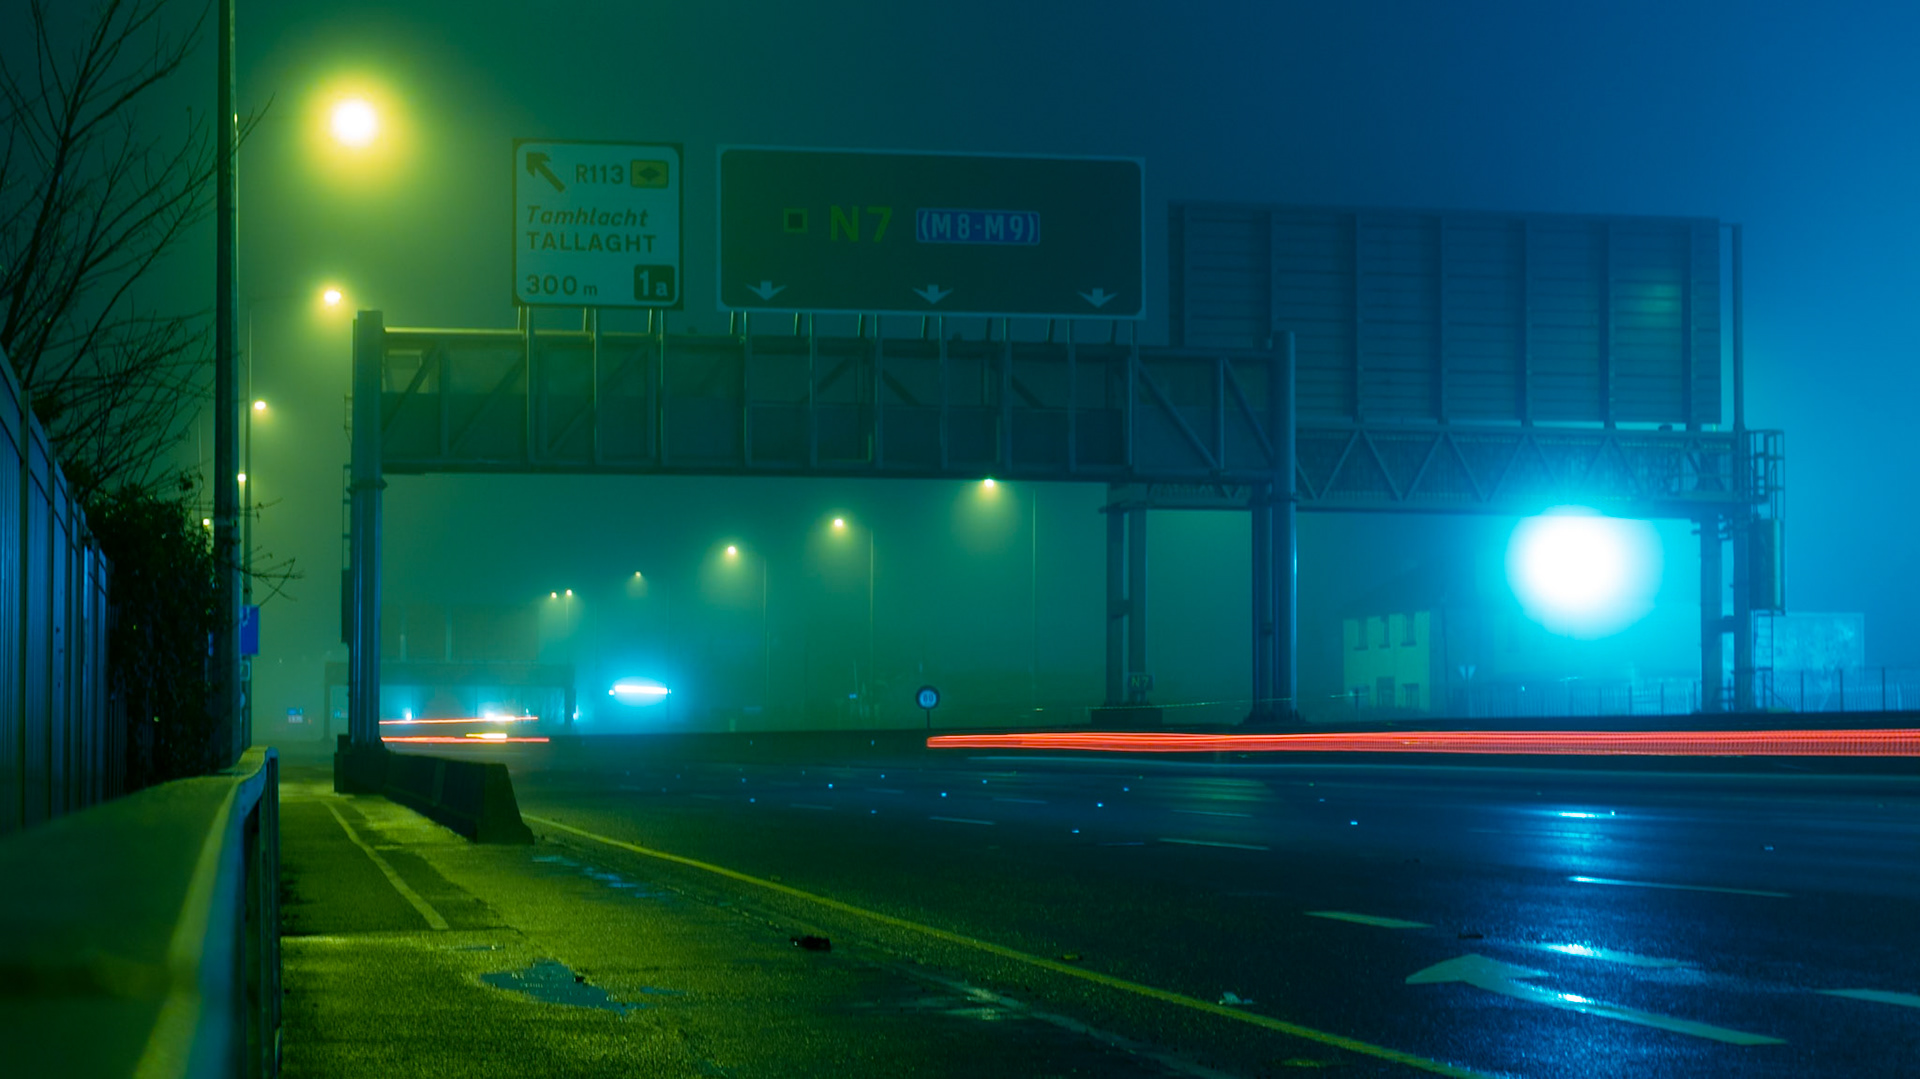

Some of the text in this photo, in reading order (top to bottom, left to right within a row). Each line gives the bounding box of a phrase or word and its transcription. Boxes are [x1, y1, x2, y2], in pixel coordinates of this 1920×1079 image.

[576, 164, 624, 185] R113
[526, 206, 648, 227] Tamhlacht
[830, 204, 892, 242] N7
[526, 231, 656, 253] TALLAGHT
[639, 270, 669, 297] 1a
[1131, 676, 1149, 688] N7
